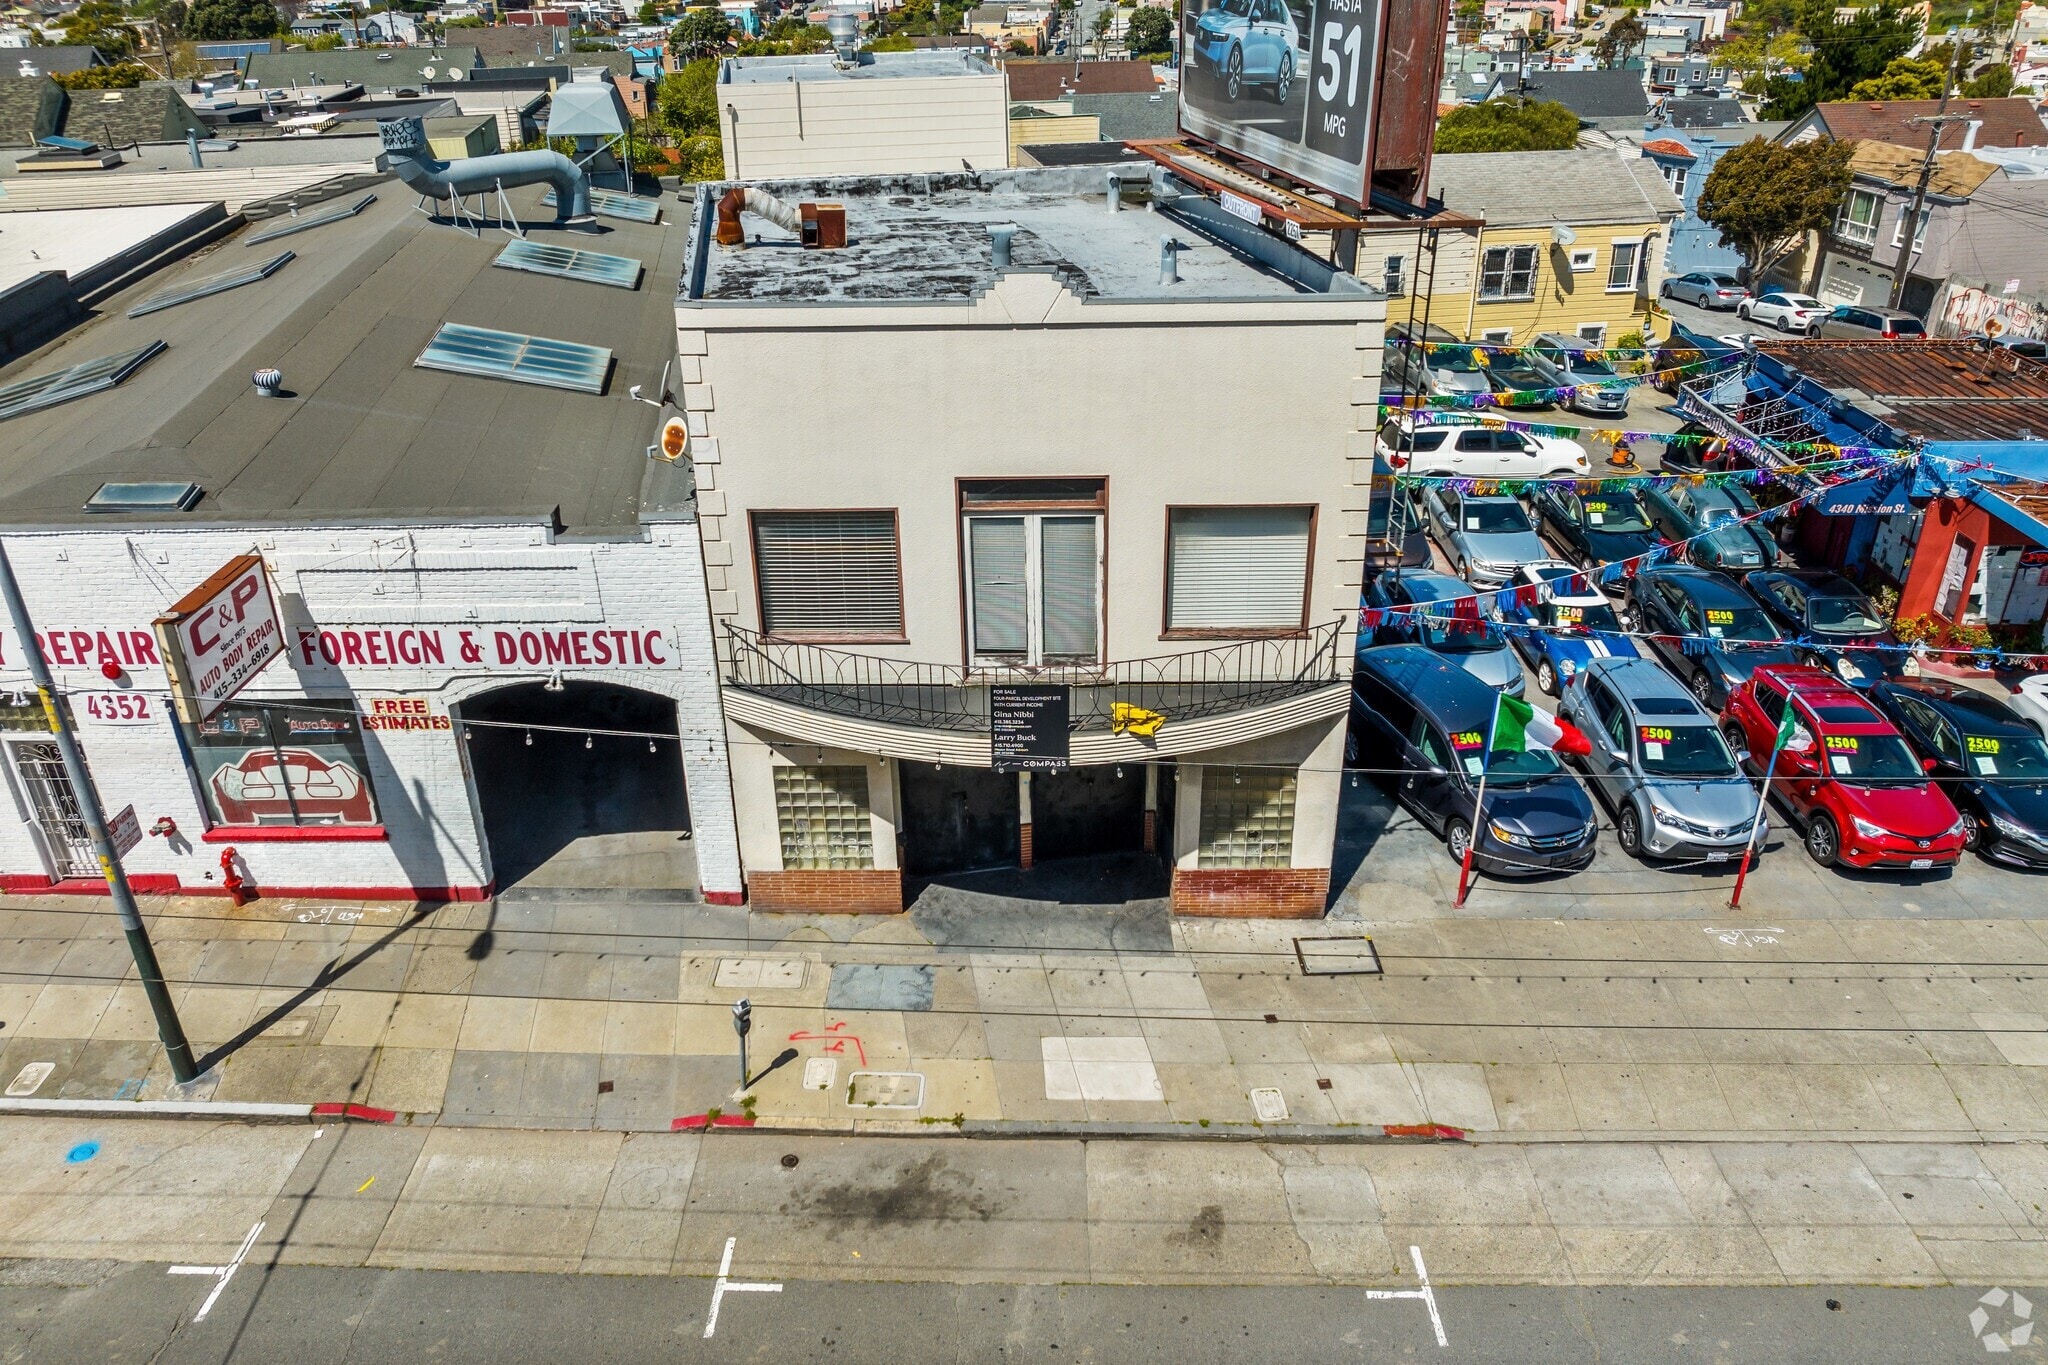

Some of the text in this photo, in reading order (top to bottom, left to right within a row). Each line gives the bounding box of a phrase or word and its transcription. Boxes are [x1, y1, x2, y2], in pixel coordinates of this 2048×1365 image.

[1318, 21, 1362, 107] 51
[1323, 112, 1346, 137] MPG
[1224, 195, 1257, 221] OUTFRONT
[1828, 503, 1906, 514] 4340 Mission St.
[1556, 606, 1583, 617] 2500
[1706, 610, 1734, 620] 2500
[220, 636, 235, 653] Since
[298, 629, 666, 666] FOREIGN & DOMESTIC
[199, 619, 274, 695] AUTO BODY REPAIR
[214, 643, 270, 699] 415-334-6918
[88, 695, 150, 720] 4352
[373, 700, 428, 714] FREE
[361, 715, 451, 731] ESTIMATES
[1451, 732, 1483, 745] 2500
[1641, 727, 1672, 740] 2500
[1825, 736, 1859, 749] 2500
[1967, 737, 2000, 750] 2500
